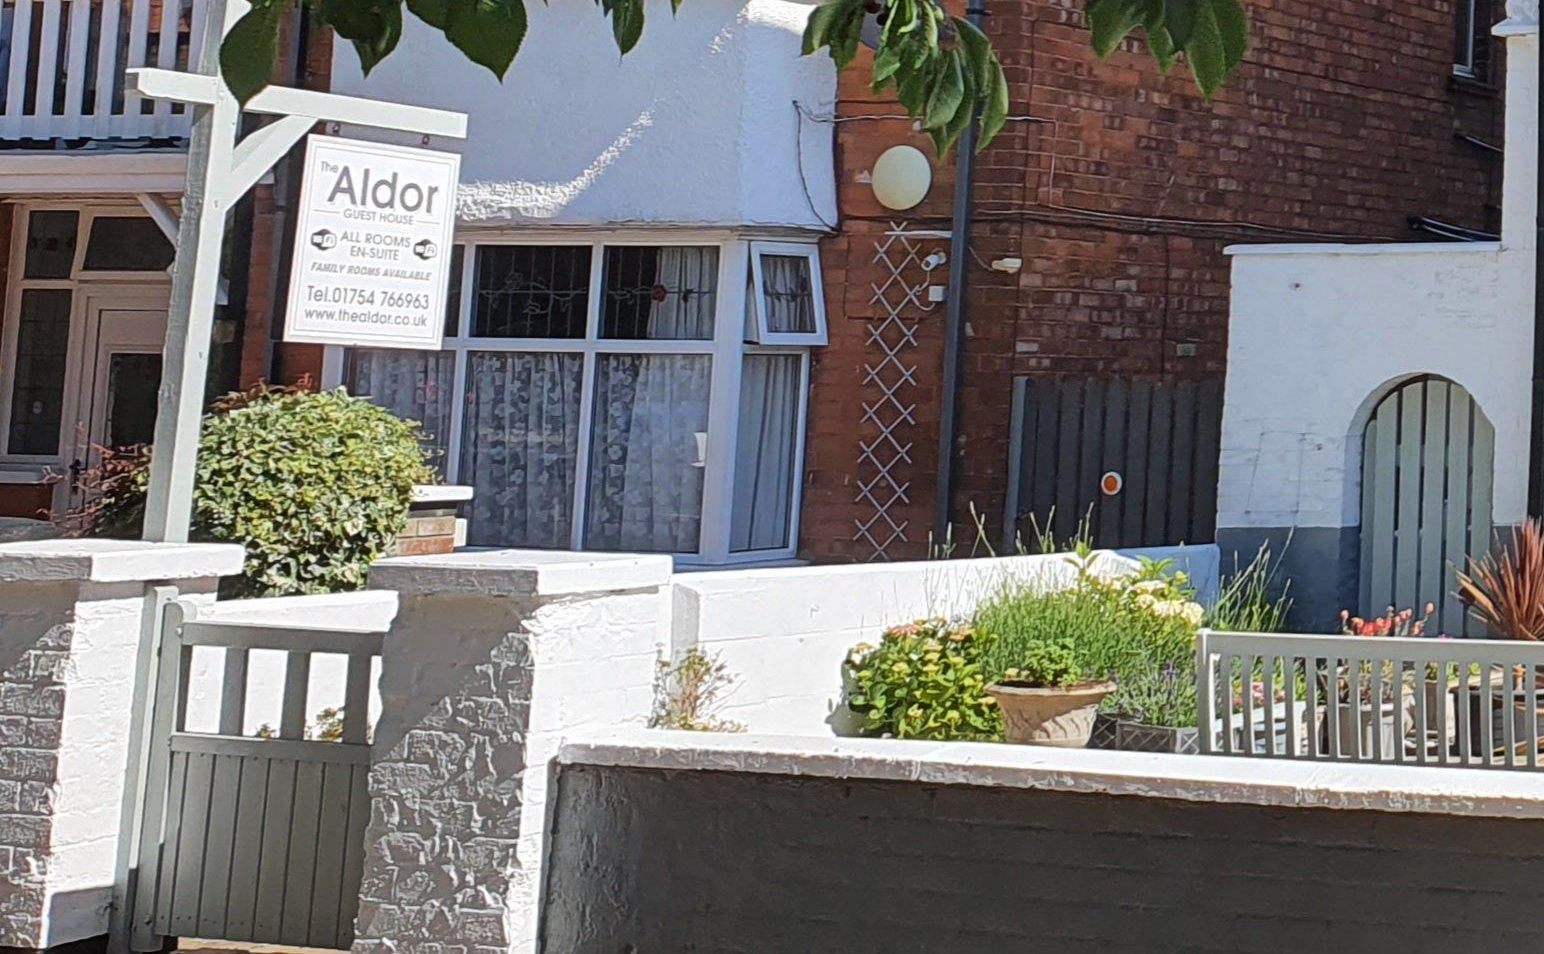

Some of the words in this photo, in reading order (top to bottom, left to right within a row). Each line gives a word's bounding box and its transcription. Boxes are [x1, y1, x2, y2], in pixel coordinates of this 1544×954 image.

[320, 161, 339, 173] The
[326, 165, 439, 213] Aldor
[343, 209, 377, 221] GUEST
[379, 213, 414, 225] HOUSE
[340, 230, 362, 244] ALL
[364, 234, 411, 248] ROOMS
[350, 246, 400, 261] EN-SUITE
[310, 261, 346, 275] FAMILY
[347, 264, 381, 277] ROOMS
[383, 267, 432, 281] AVAILABLE
[307, 285, 375, 306] Tel.01754
[380, 291, 429, 310] 766963
[304, 306, 427, 327] www.thealdor.co.uk
